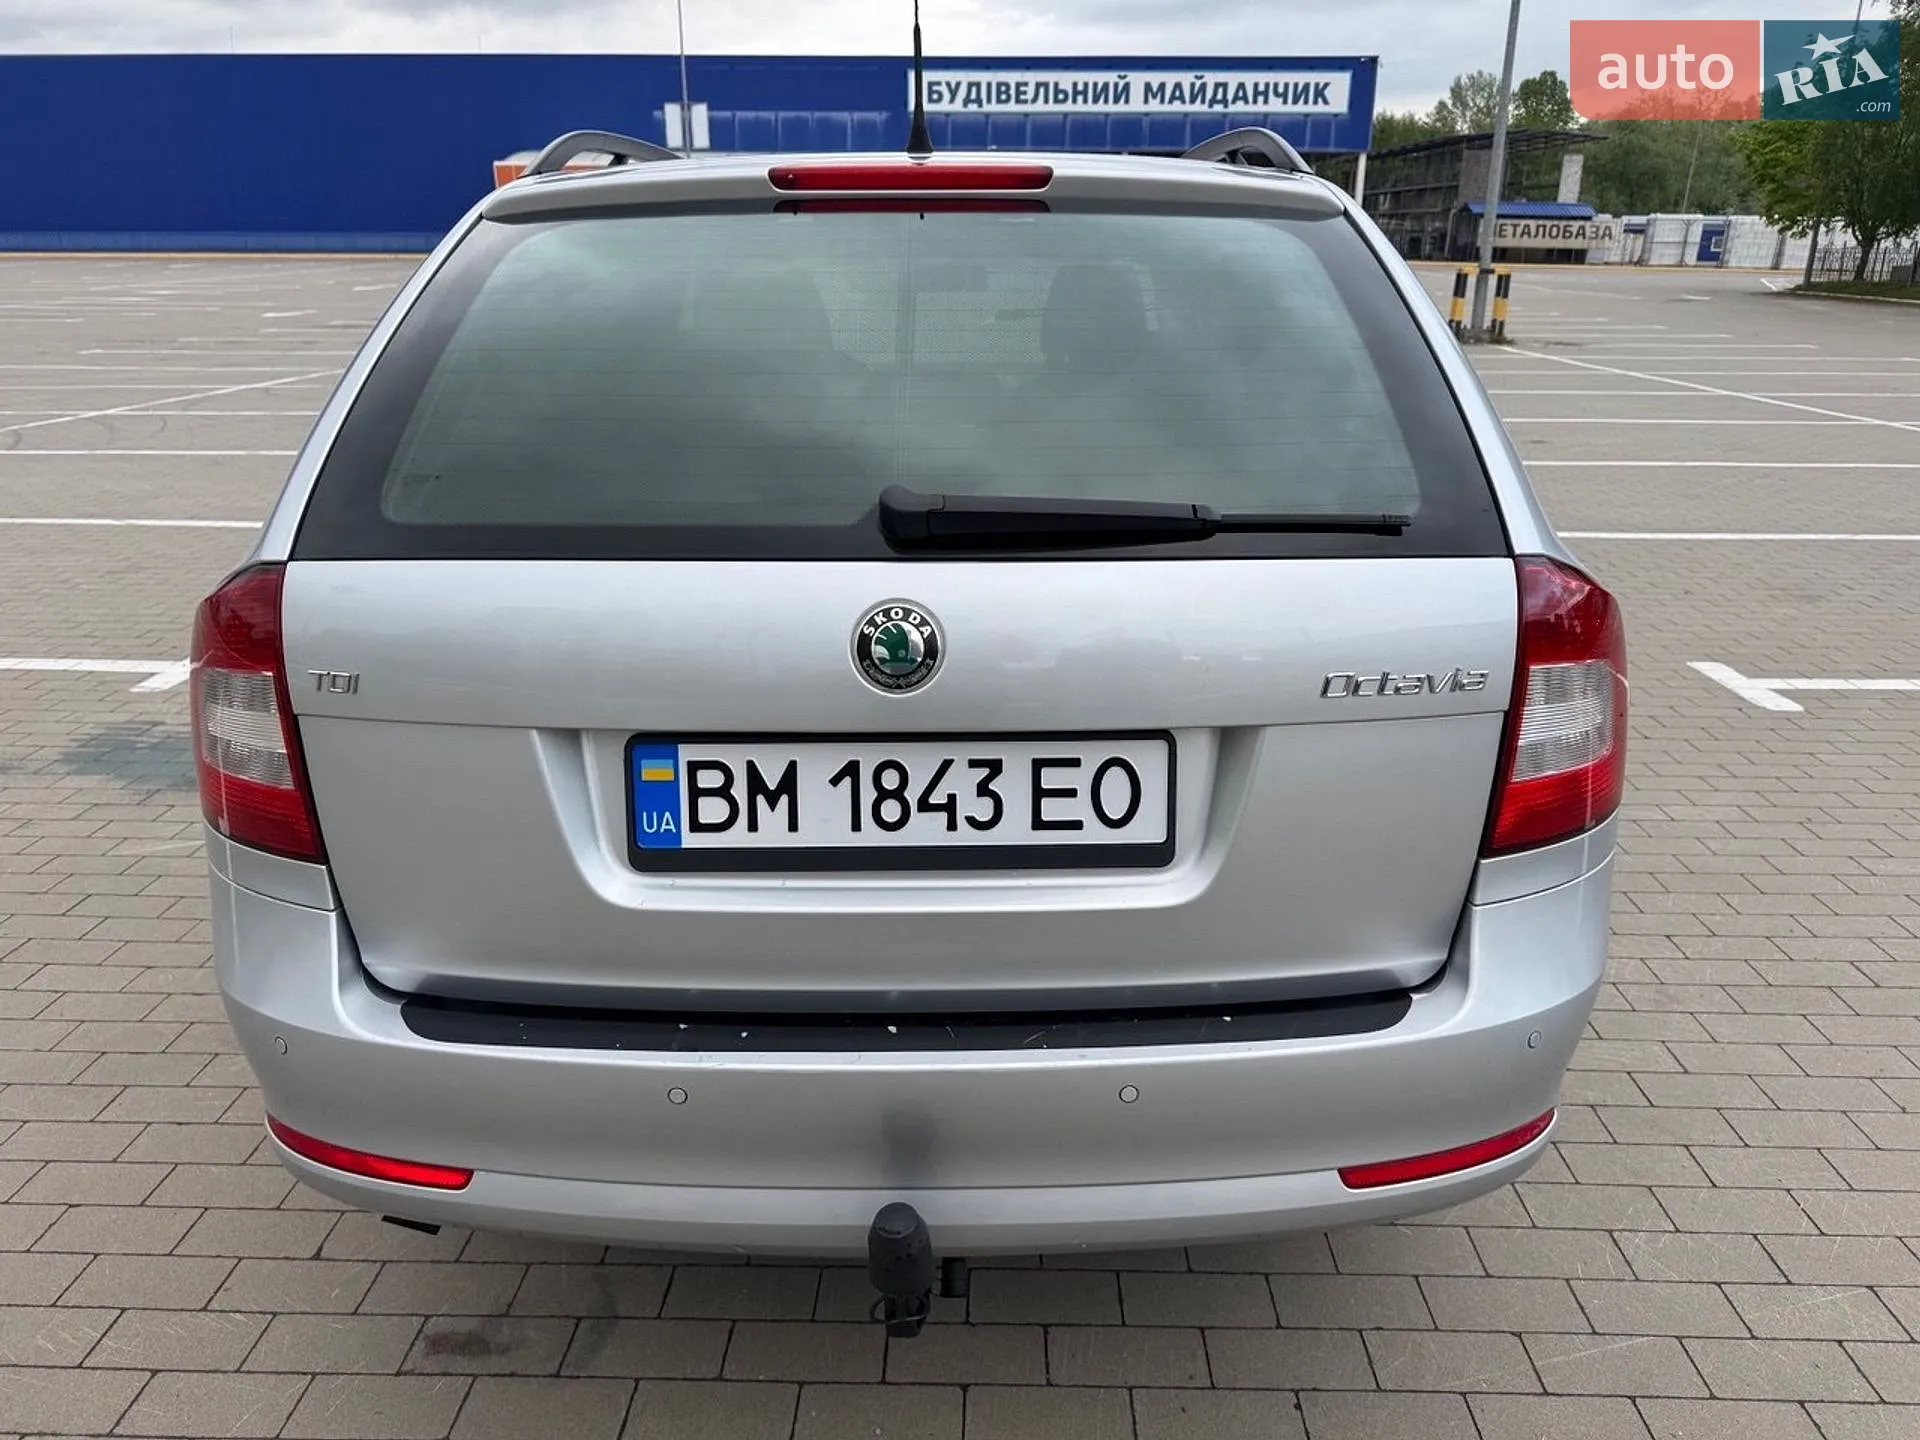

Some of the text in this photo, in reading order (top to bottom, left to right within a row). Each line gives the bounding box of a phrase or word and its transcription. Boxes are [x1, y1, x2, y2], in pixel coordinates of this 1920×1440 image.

[927, 75, 1331, 109] БУДІВЕЛЬНИЙ МАЙДАНЧИК
[1494, 223, 1612, 240] ЕТАЛОБАЗА
[307, 670, 360, 695] TDI
[1320, 668, 1489, 698] Octavia
[686, 755, 1143, 834] BM 1843 EO
[642, 811, 677, 834] UA
